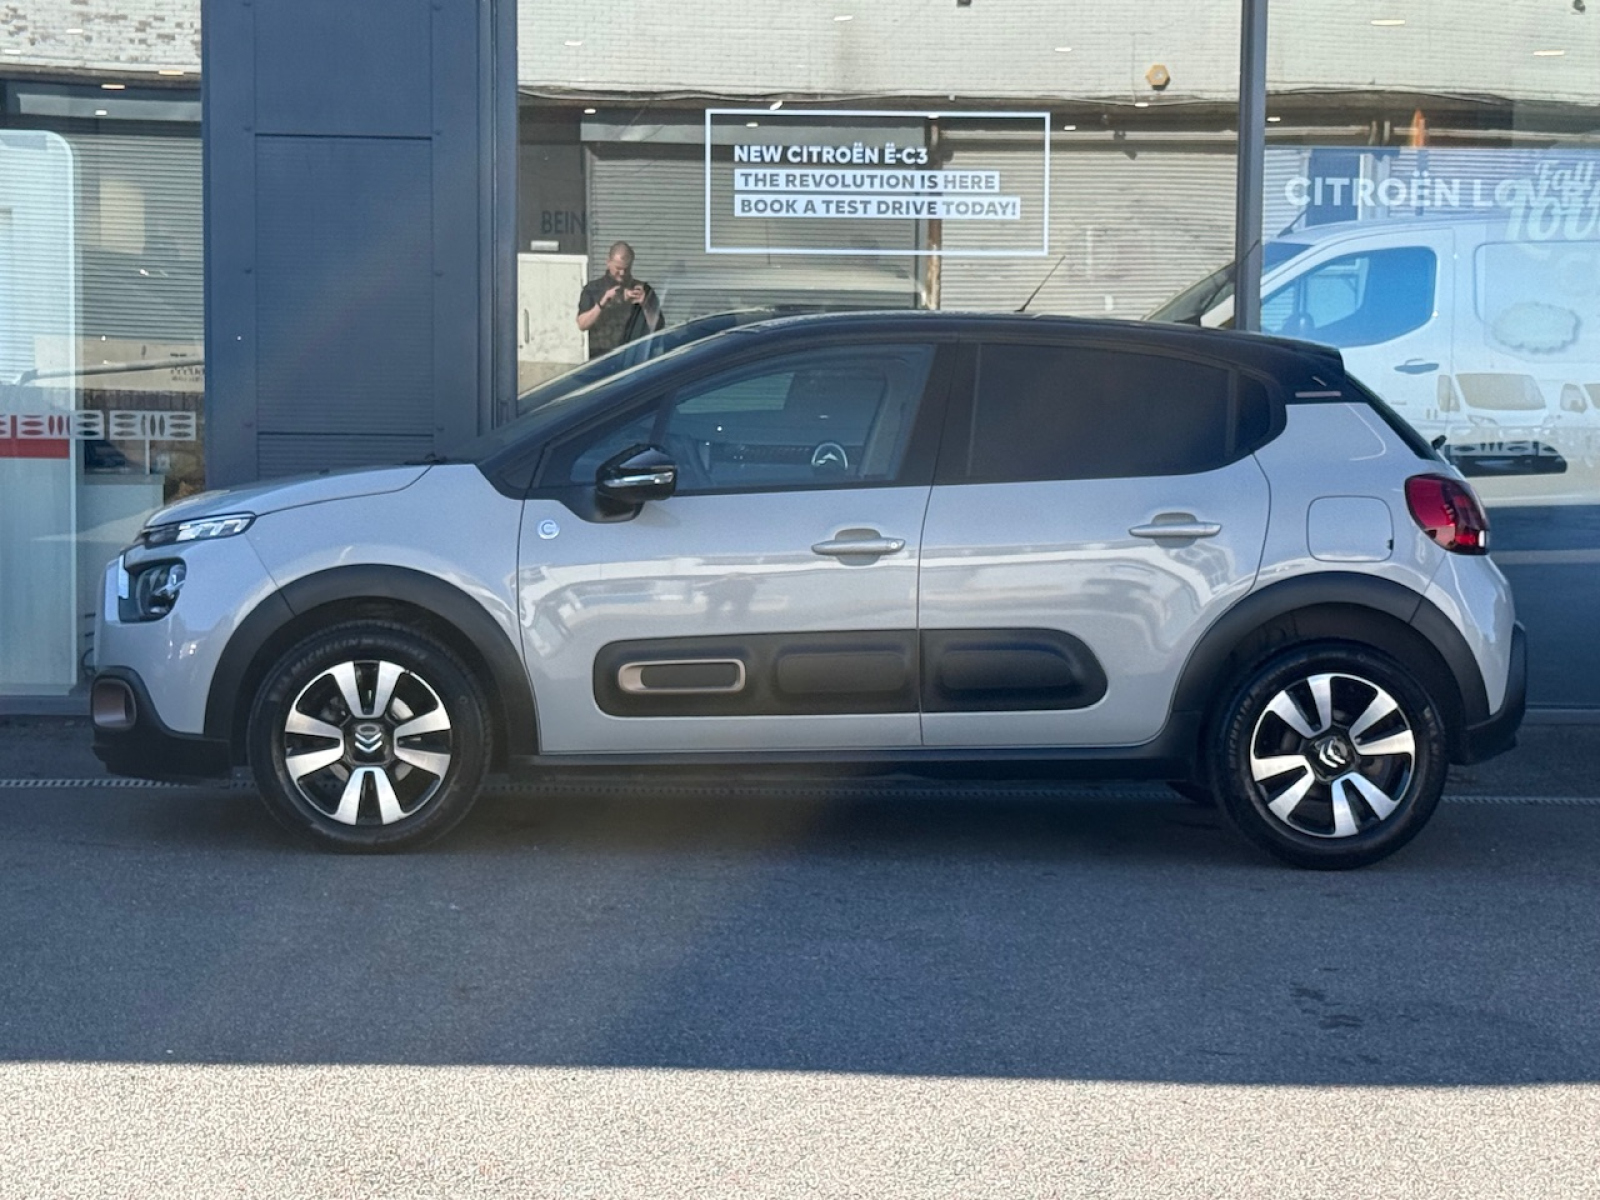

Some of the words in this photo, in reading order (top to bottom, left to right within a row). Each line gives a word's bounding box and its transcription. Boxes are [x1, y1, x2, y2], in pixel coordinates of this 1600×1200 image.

[734, 145, 783, 162] NEW
[787, 142, 880, 164] CITROËN
[884, 142, 929, 165] Ë-C3
[740, 173, 780, 187] THE
[785, 174, 915, 189] REVOLUTION
[921, 175, 938, 189] IS
[943, 175, 996, 190] HERE
[1284, 170, 1460, 206] CITROËN
[741, 199, 798, 214] BOOK
[803, 200, 817, 214] A
[822, 200, 871, 215] TEST
[877, 200, 938, 216] DRIVE
[941, 201, 1017, 216] TODAY!
[291, 637, 359, 677] MICHELIN
